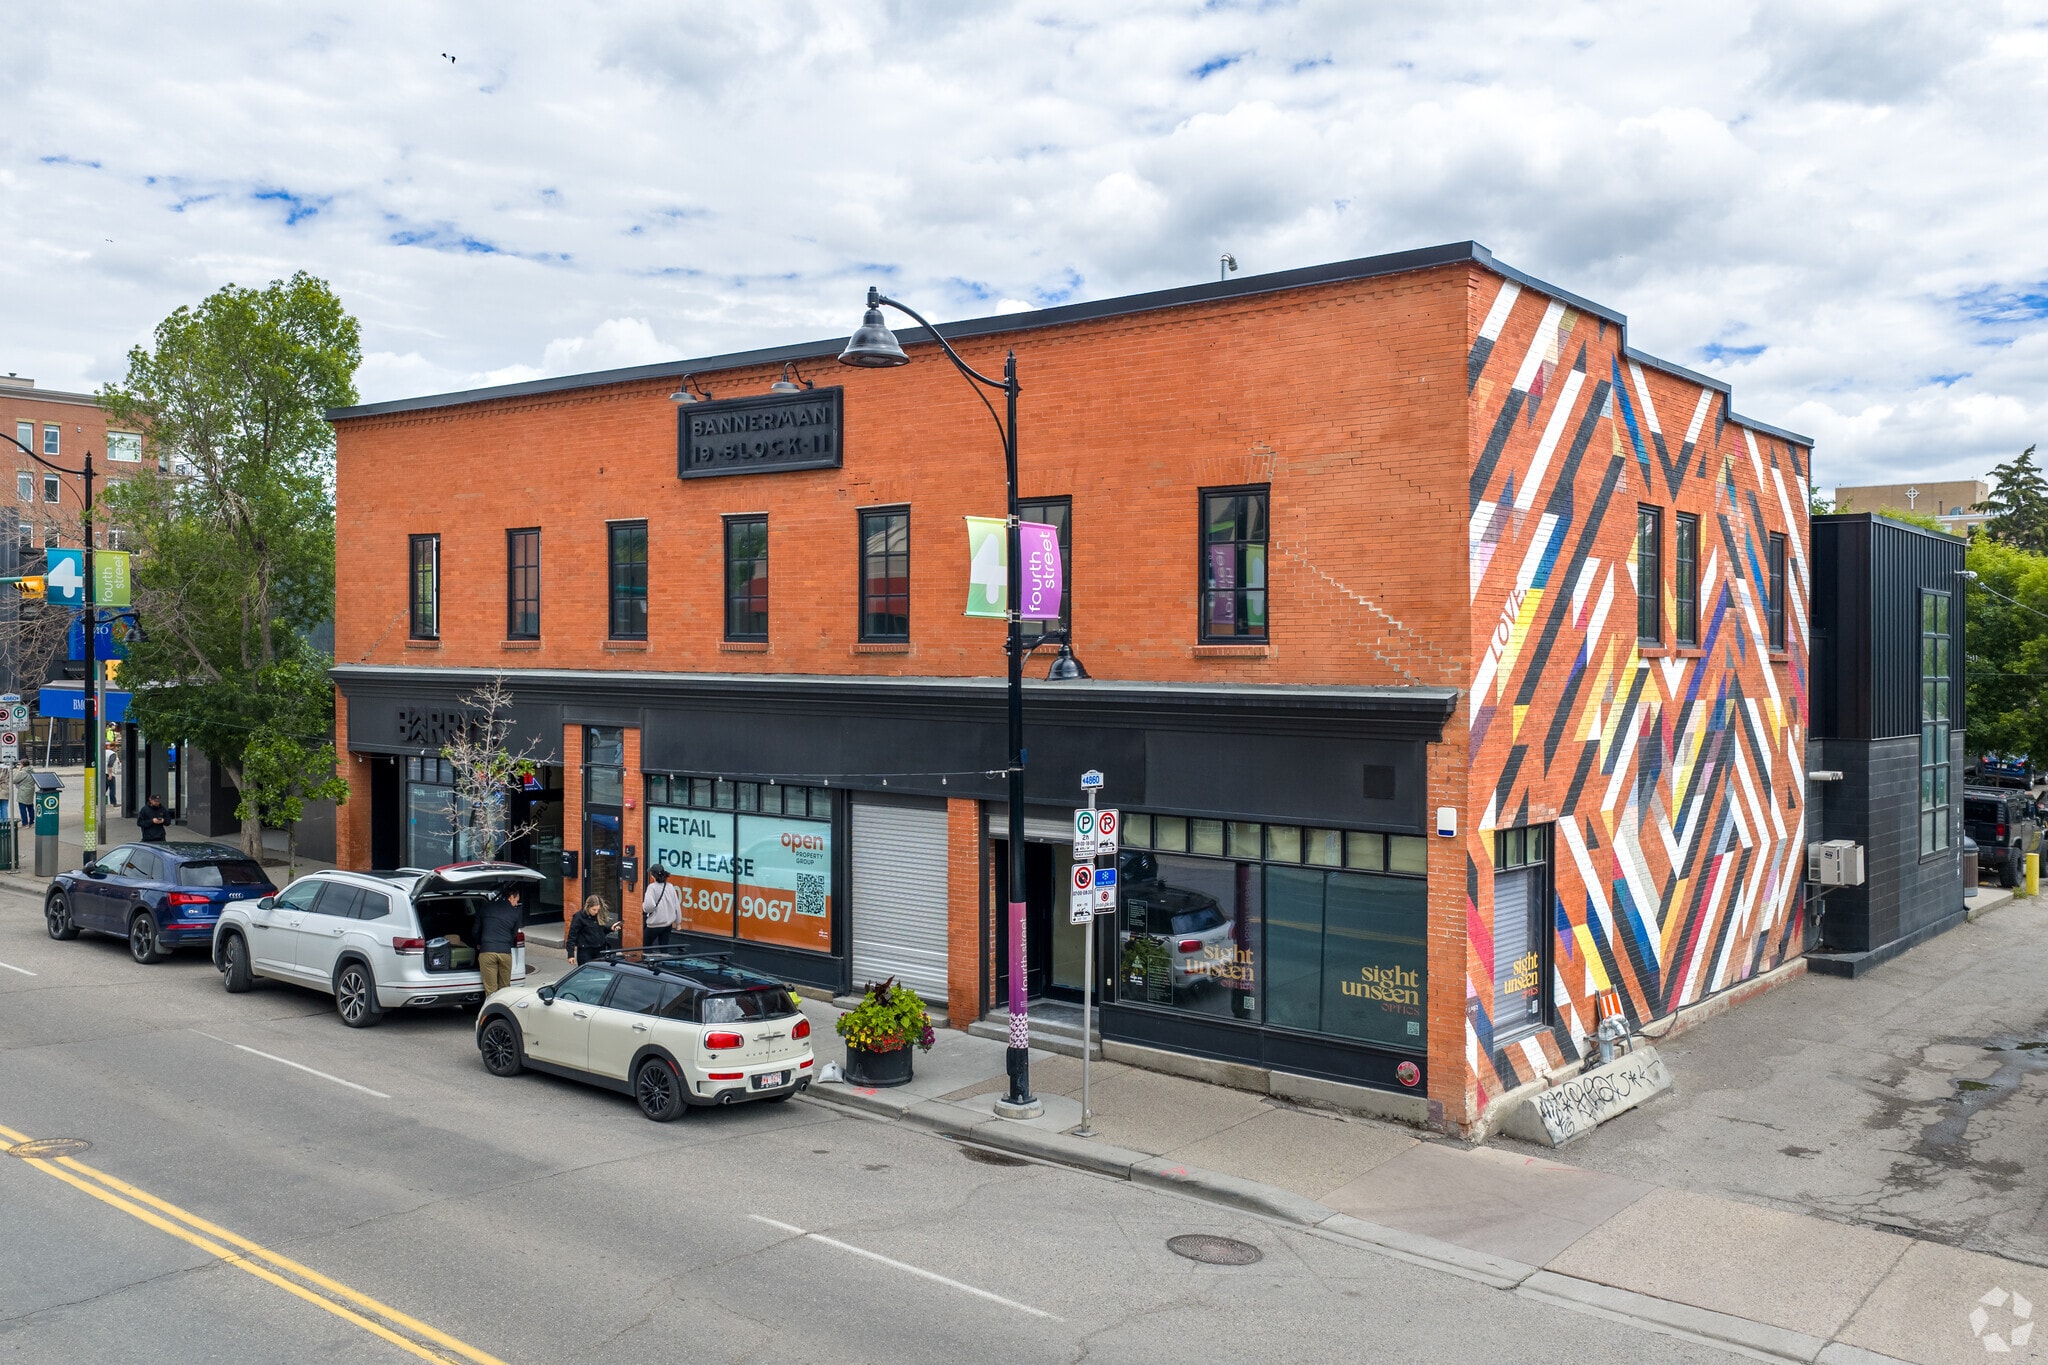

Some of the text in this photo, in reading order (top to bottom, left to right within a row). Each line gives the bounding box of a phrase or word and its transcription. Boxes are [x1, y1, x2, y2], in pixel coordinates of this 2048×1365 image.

[692, 406, 830, 437] BANNERMAN
[113, 555, 124, 589] street
[1040, 531, 1055, 589] street
[102, 567, 113, 602] fourth
[1029, 551, 1042, 612] fourth
[1086, 775, 1100, 785] 4860
[658, 815, 716, 839] RETAIL
[781, 832, 824, 853] open
[658, 848, 754, 877] FOR LEASE
[795, 851, 824, 860] PROPERTY
[795, 857, 815, 866] GROUP
[675, 885, 793, 924] 03.807.9067
[1203, 944, 1254, 966] sight
[1513, 951, 1539, 976] sight
[1020, 955, 1028, 992] fourth
[1185, 958, 1255, 982] unseen
[1361, 964, 1420, 988] sight
[1341, 980, 1420, 1006] unseen
[1504, 971, 1538, 995] unseen
[1381, 1003, 1420, 1016] OPTICS
